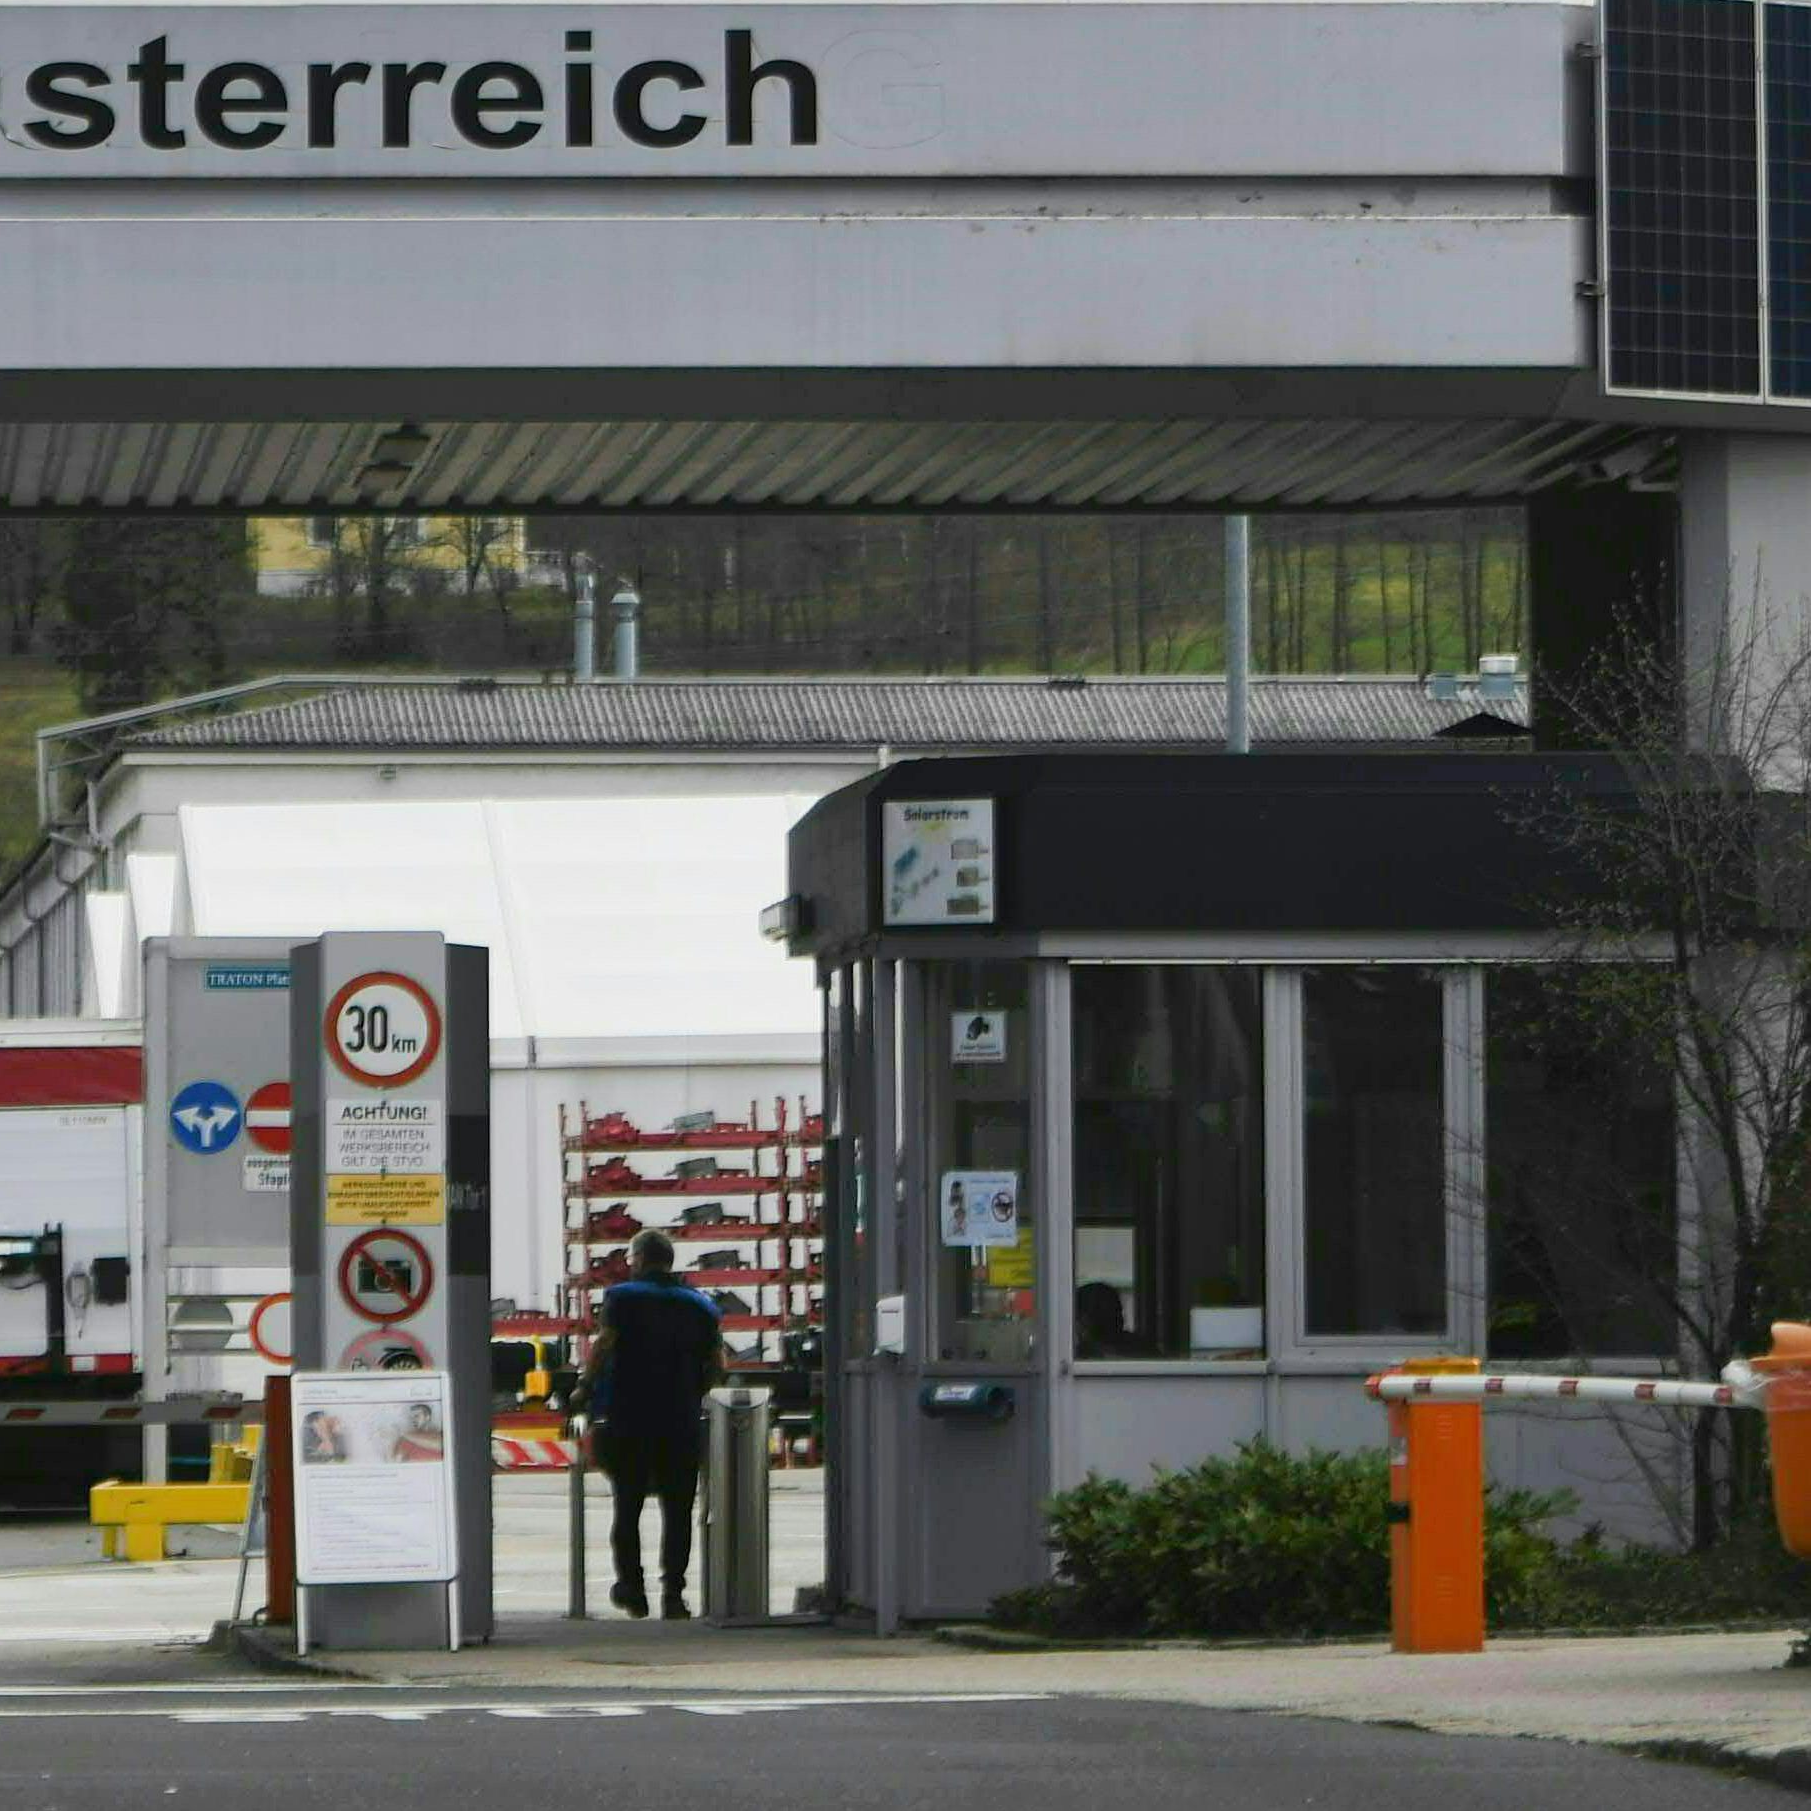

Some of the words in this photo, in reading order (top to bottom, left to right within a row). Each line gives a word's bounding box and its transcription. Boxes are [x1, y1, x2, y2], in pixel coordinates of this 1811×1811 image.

[209, 972, 263, 986] TRATON
[344, 1004, 389, 1054] 30
[391, 1034, 417, 1054] km
[341, 1106, 427, 1120] ACHTUNG!
